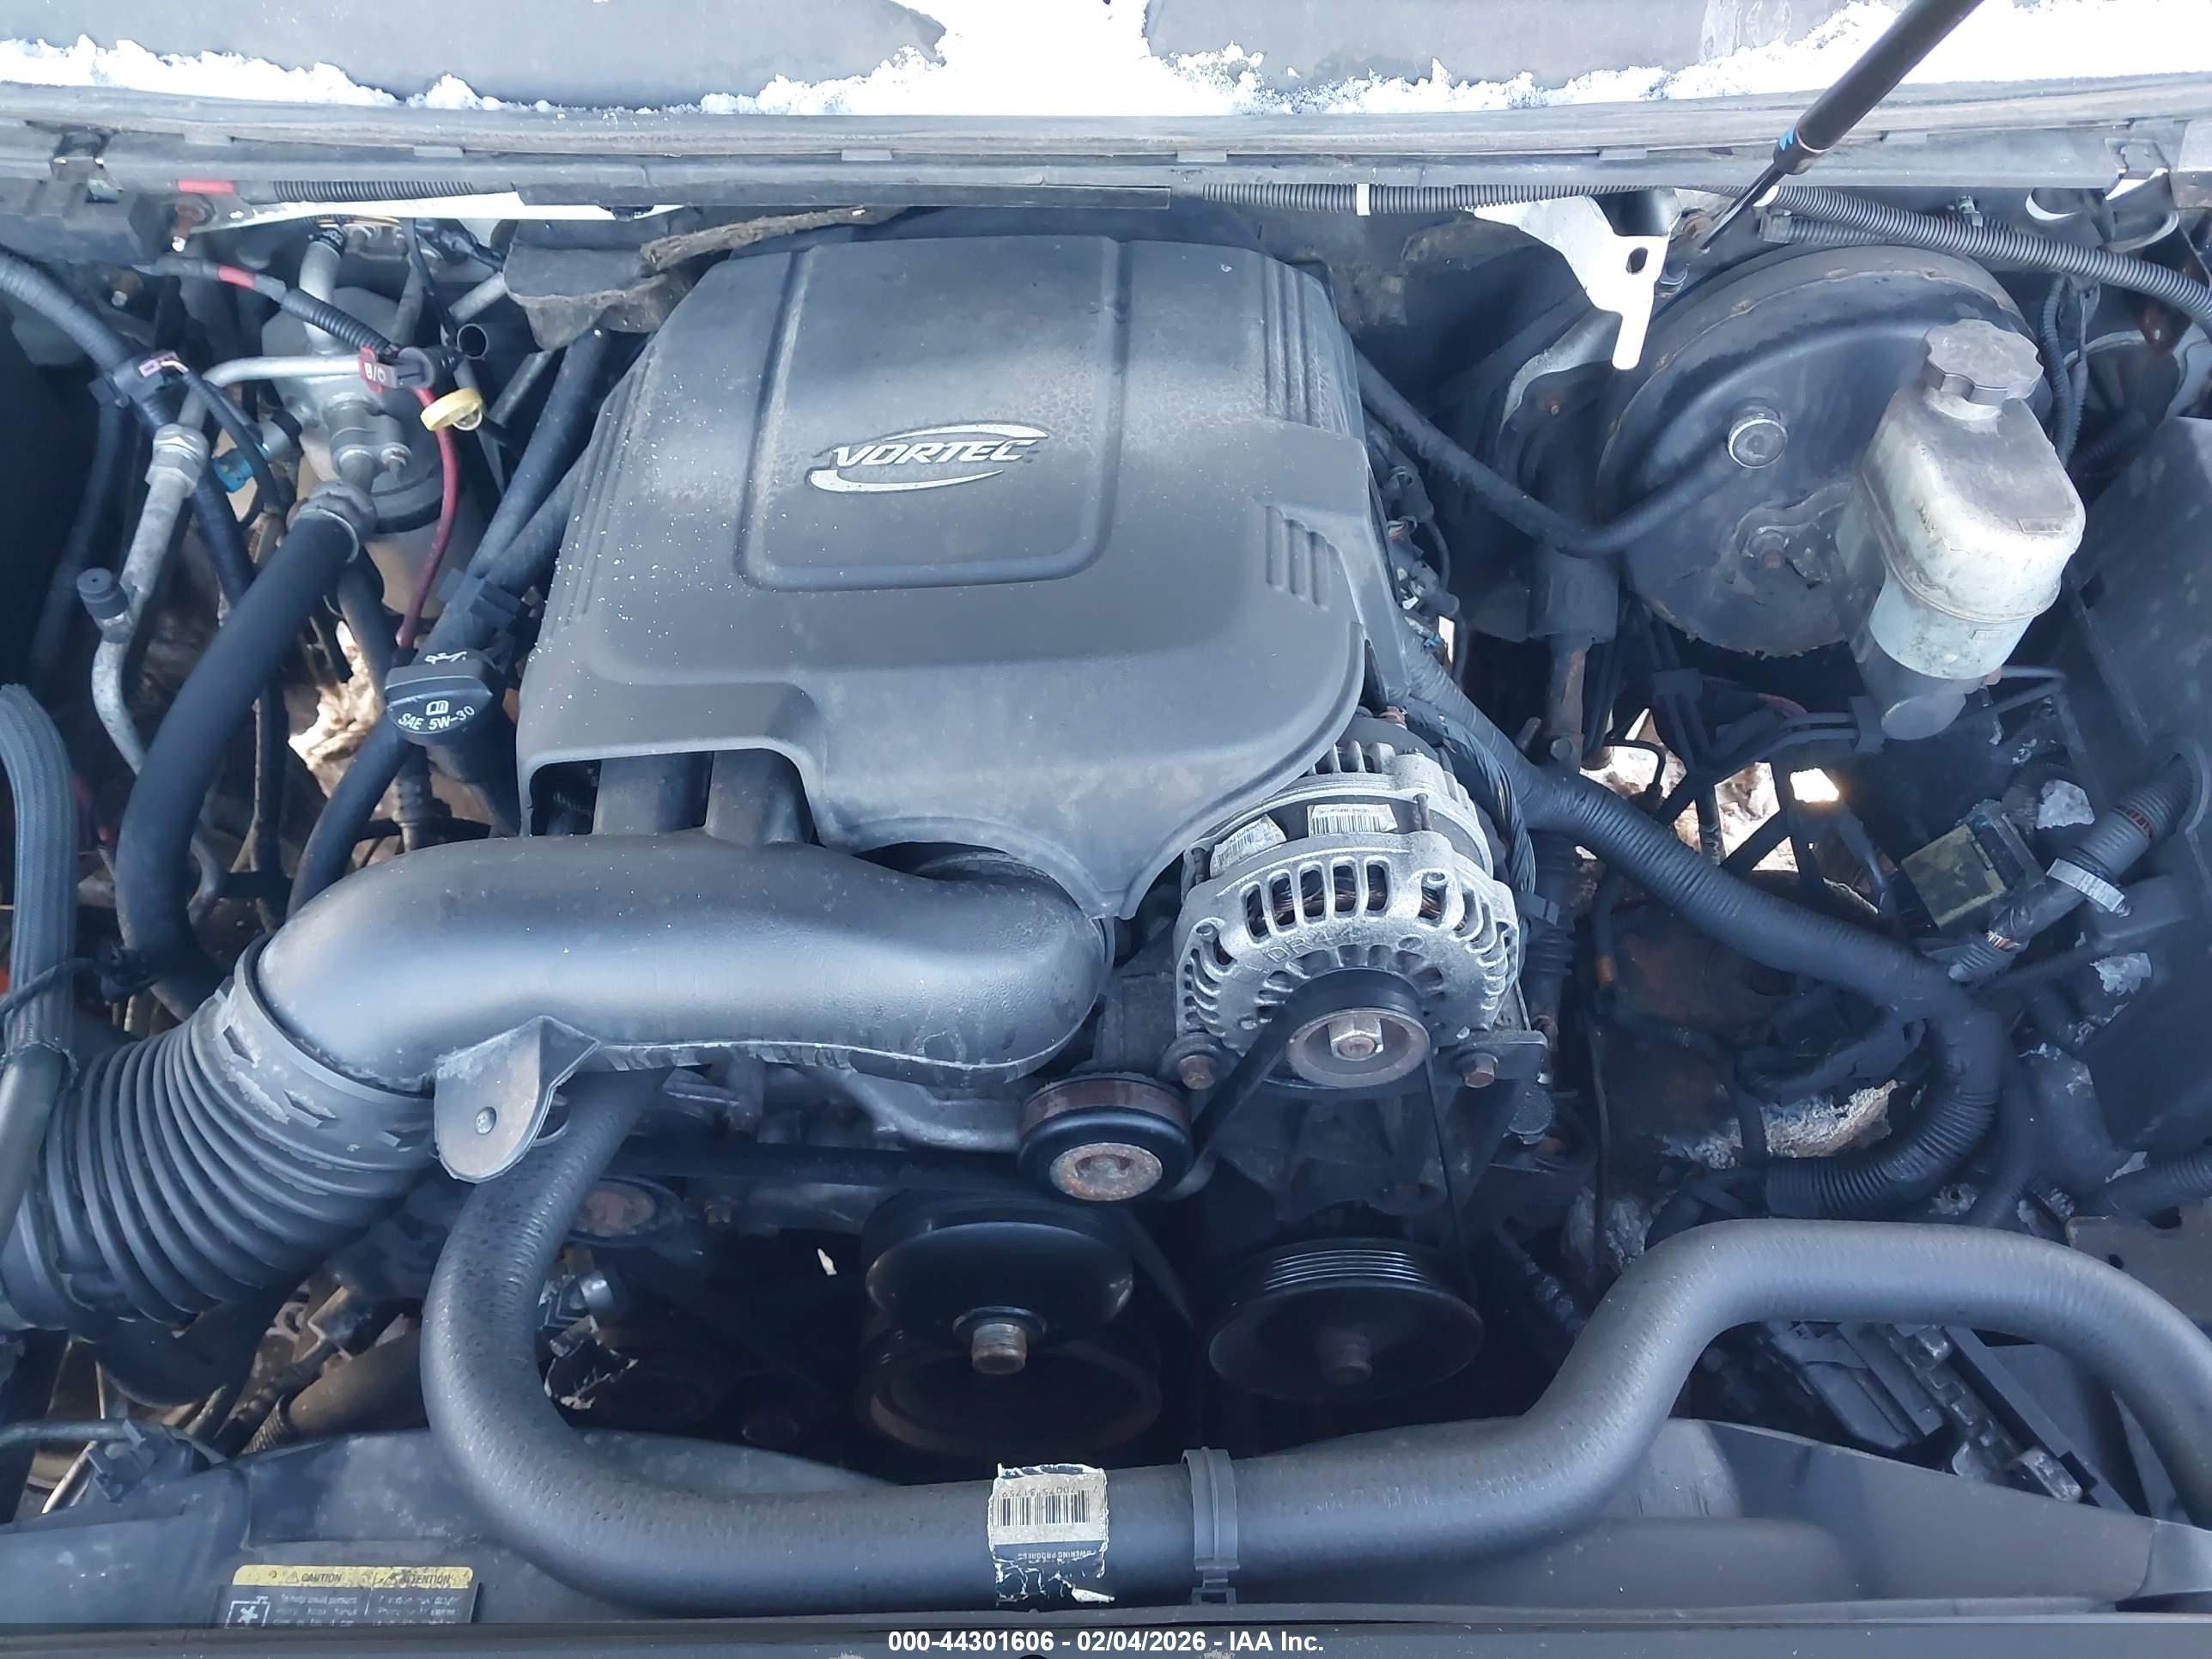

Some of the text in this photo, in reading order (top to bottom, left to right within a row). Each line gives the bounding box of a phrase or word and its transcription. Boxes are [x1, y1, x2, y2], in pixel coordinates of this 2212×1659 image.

[832, 439, 1037, 467] VORTEC
[398, 705, 475, 731] SAE 5W-30
[301, 1572, 343, 1583] CAUTION
